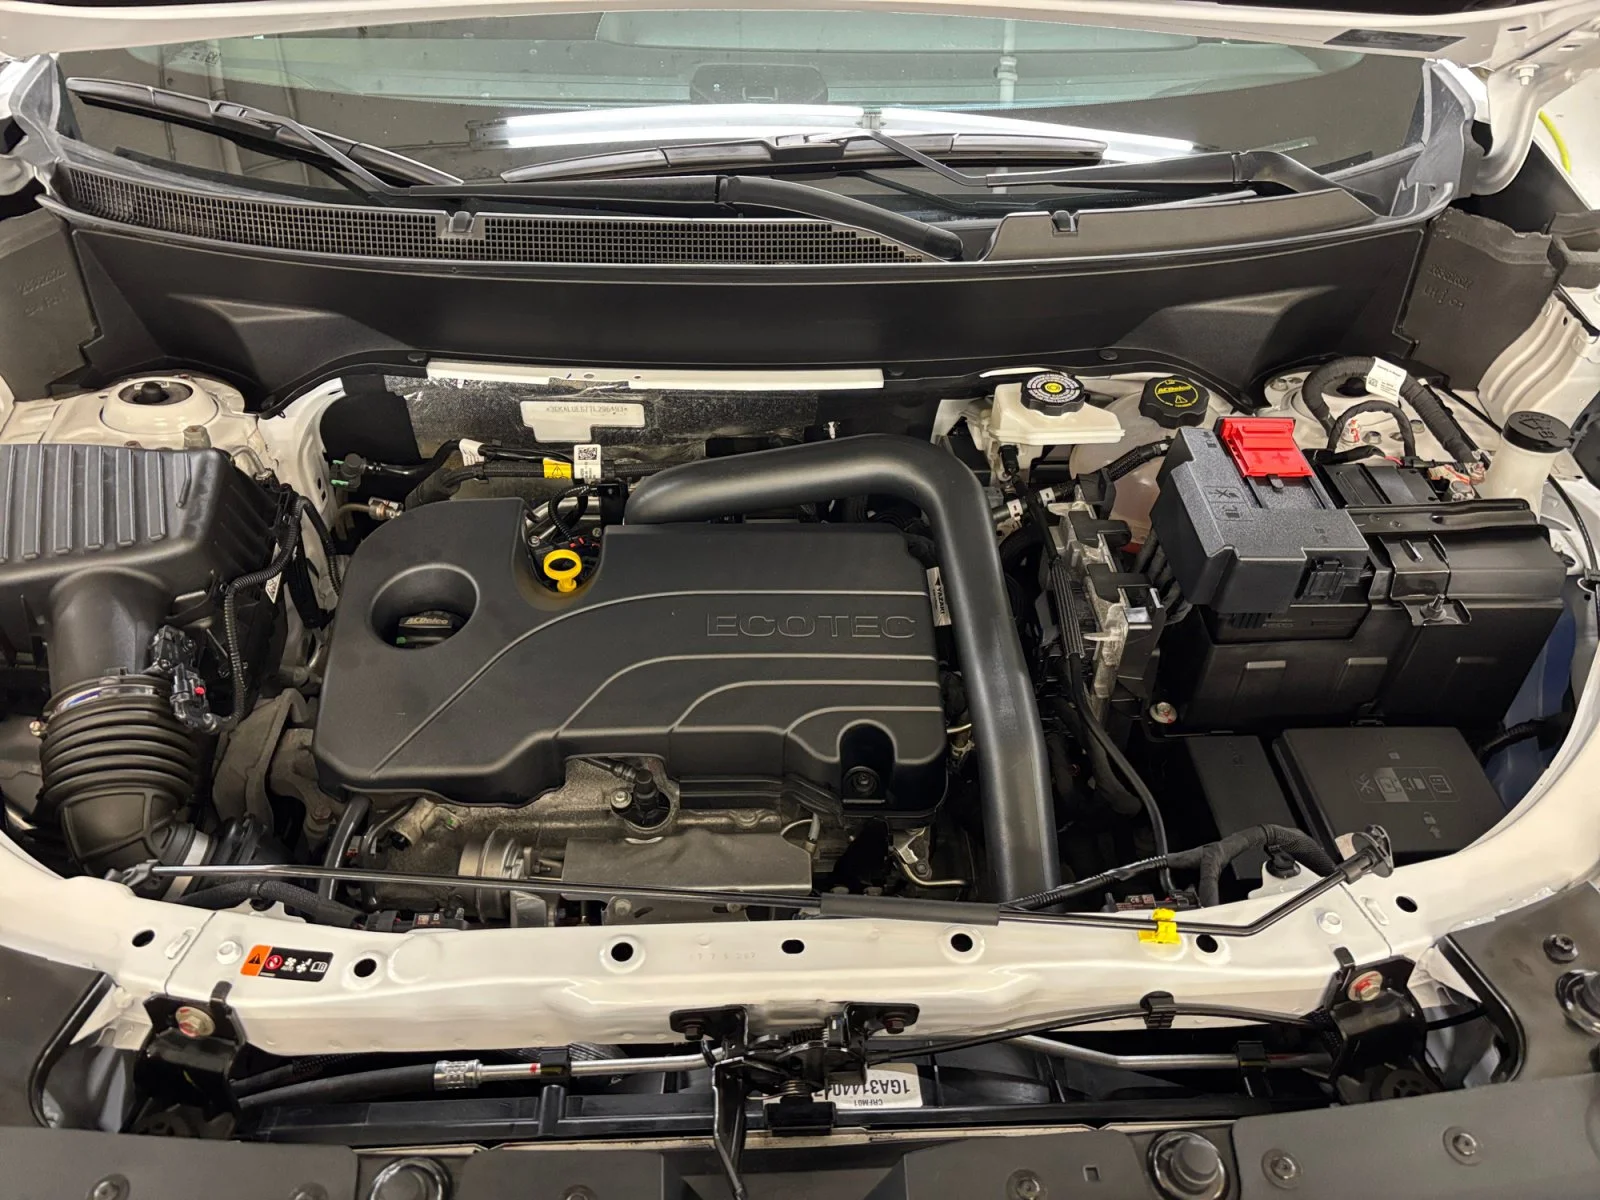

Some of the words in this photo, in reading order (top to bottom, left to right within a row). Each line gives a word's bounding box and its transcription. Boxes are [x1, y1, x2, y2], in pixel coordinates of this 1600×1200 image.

[936, 587, 945, 614] YAZAKI
[404, 616, 449, 625] ACDelco
[707, 613, 916, 639] ECOTEC
